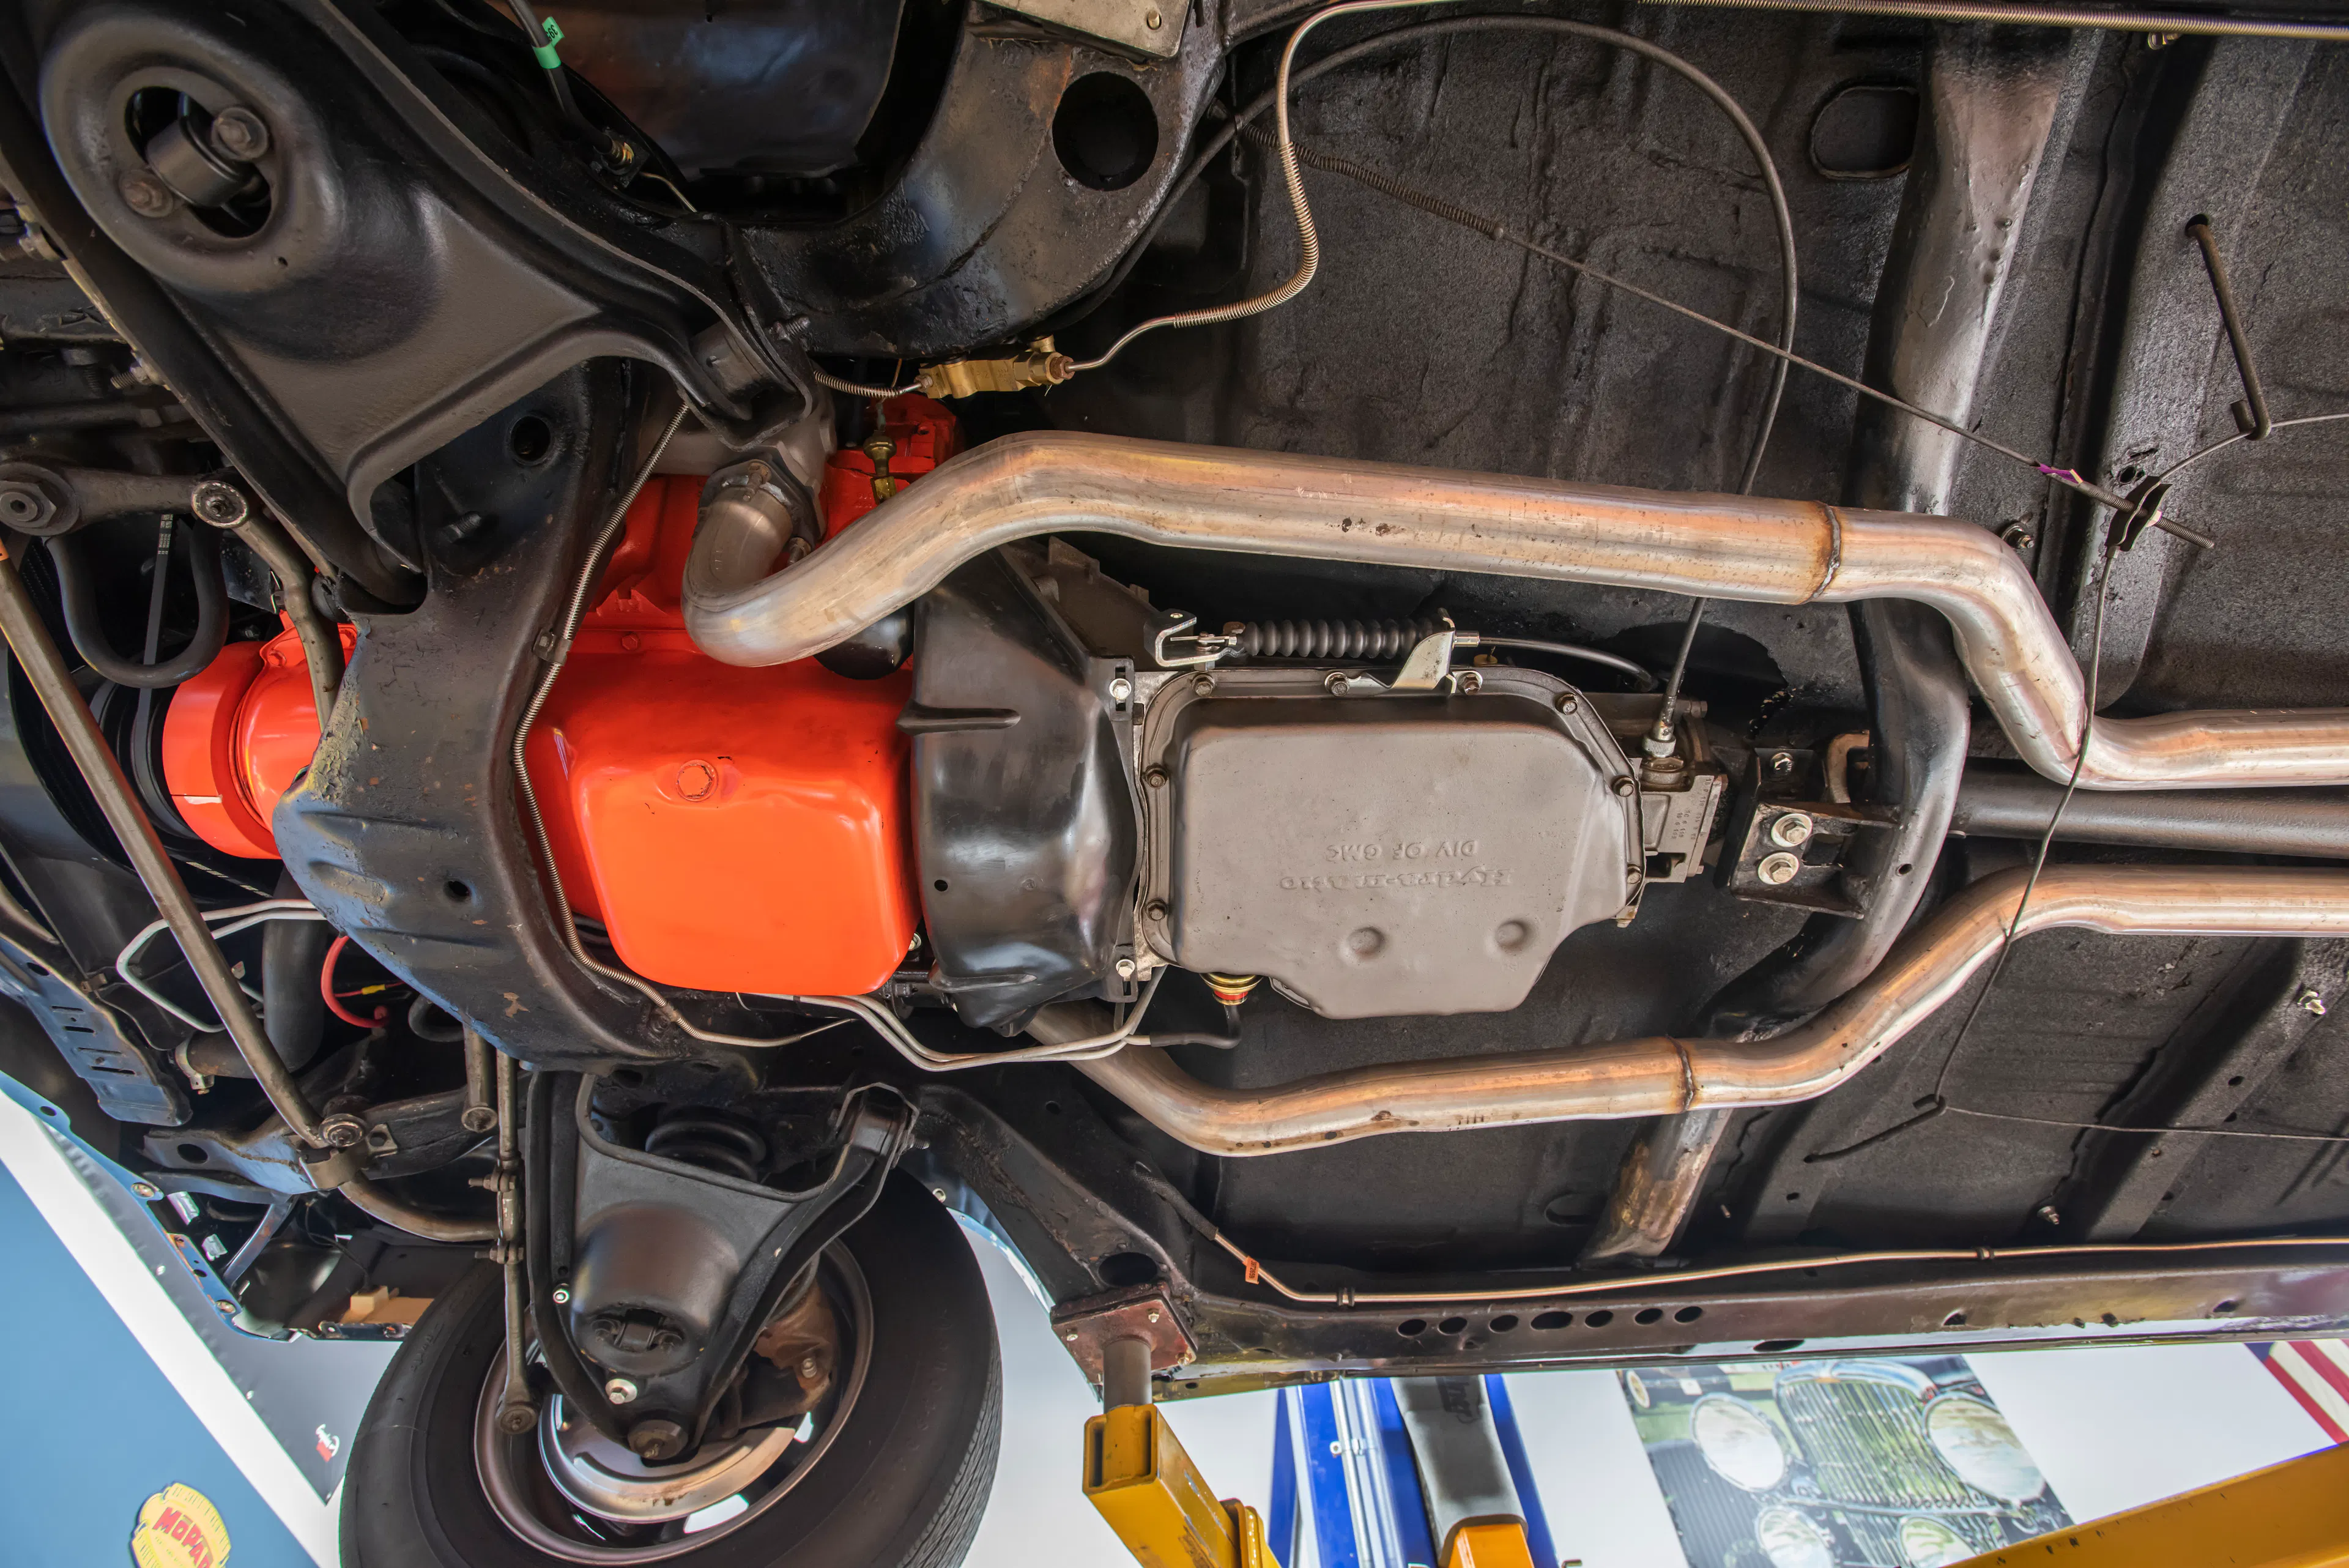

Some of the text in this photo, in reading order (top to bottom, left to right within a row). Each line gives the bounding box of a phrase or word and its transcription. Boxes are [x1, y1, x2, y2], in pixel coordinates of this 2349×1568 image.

[1325, 840, 1478, 861] DIV OF GMC
